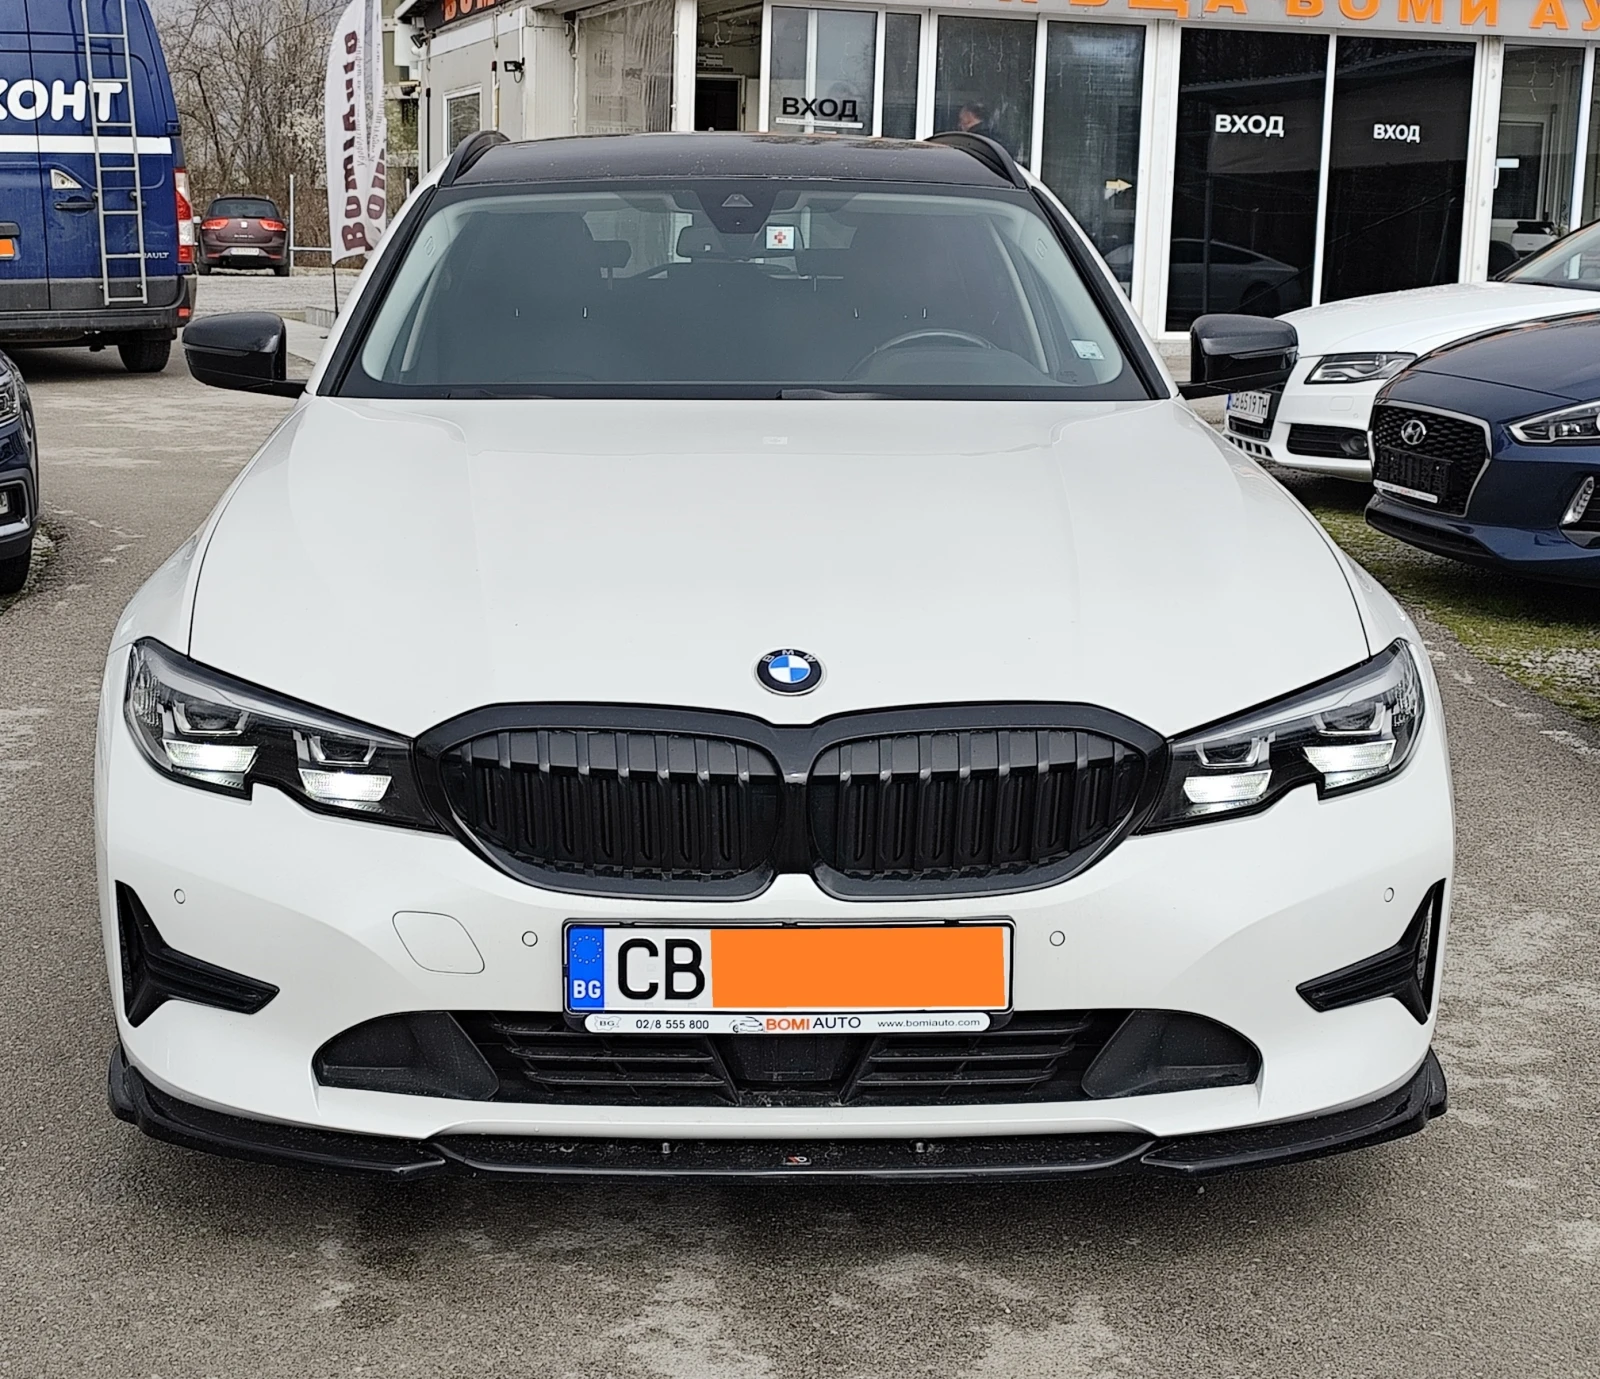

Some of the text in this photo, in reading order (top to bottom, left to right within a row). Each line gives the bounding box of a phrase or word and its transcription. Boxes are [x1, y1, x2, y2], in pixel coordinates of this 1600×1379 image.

[0, 79, 122, 121] ОНТ
[782, 97, 858, 122] ВХОД
[1215, 114, 1284, 137] ВХОД
[1373, 124, 1420, 143] ВХОД
[762, 649, 817, 662] BMW
[618, 938, 705, 1000] CB
[573, 980, 601, 999] BG
[635, 1019, 709, 1030] 02/8 555 800
[766, 1016, 862, 1031] BOMI AUTO
[877, 1018, 981, 1028] www.bomiauto.com
